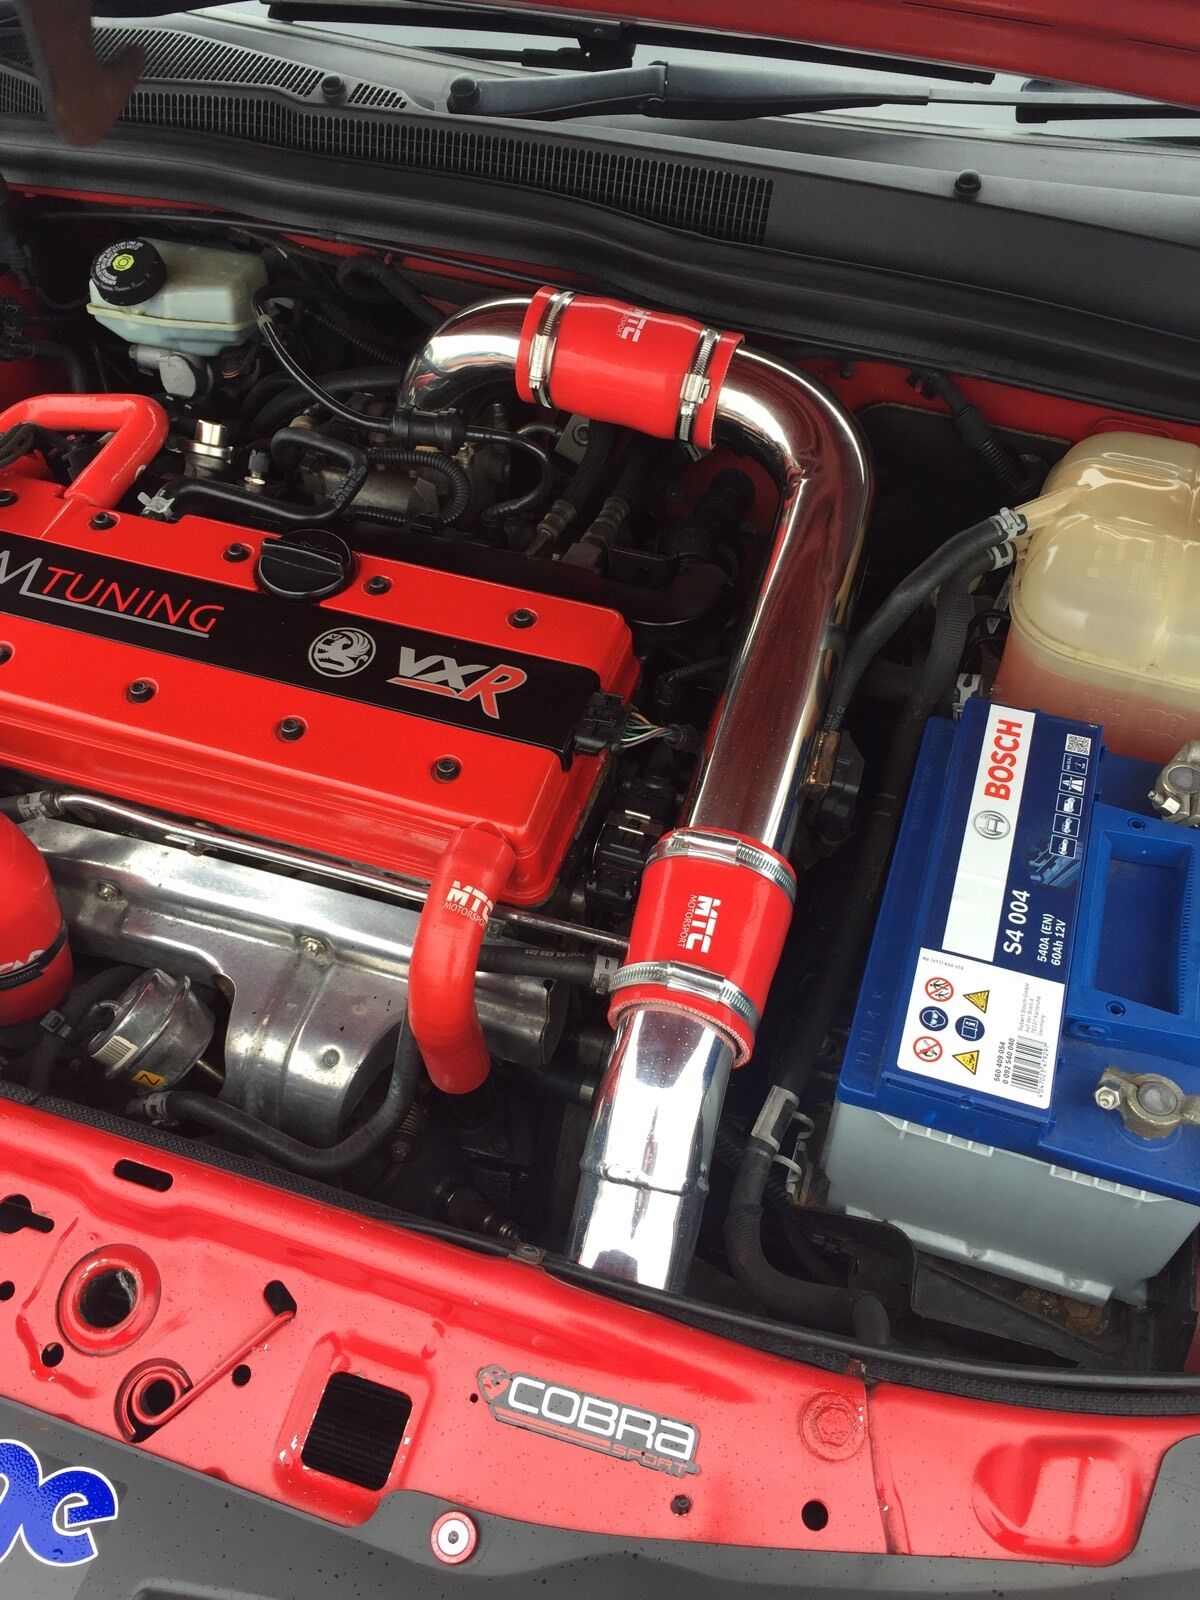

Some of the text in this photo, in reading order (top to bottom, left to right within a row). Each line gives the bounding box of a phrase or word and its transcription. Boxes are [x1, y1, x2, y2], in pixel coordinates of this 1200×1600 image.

[397, 646, 528, 719] VXR
[983, 718, 1023, 801] BOSCH
[677, 894, 698, 948] MOTORSPORT
[685, 895, 721, 953] MTC
[1002, 889, 1031, 956] S4 004
[1036, 913, 1055, 963] 540A (EN)
[1051, 918, 1067, 966] 60Ah 12V
[993, 1041, 1006, 1082] 560 409 054
[1003, 1065, 1011, 1079] 092
